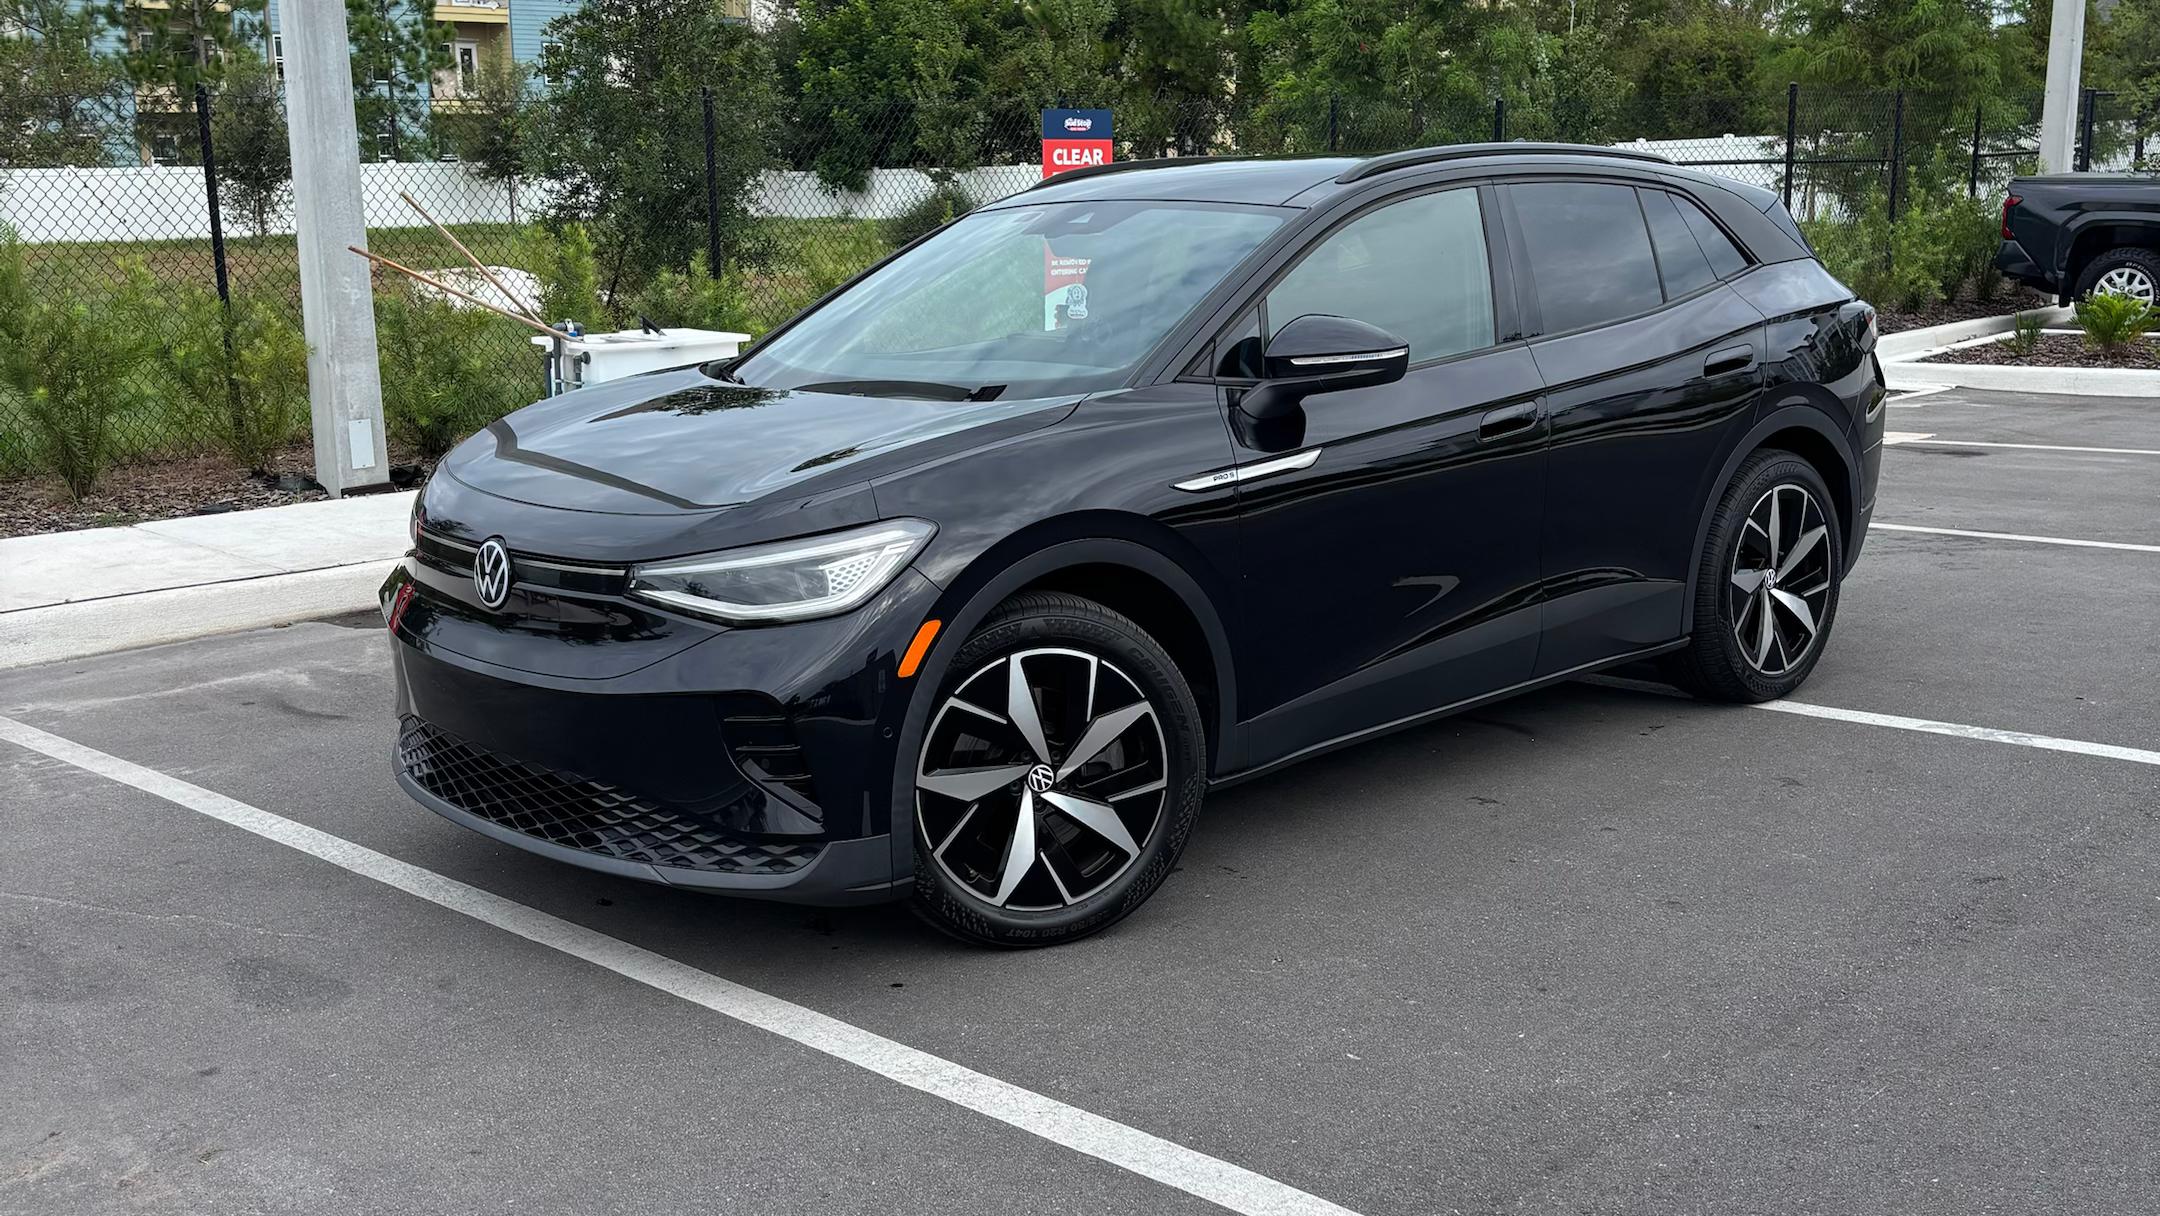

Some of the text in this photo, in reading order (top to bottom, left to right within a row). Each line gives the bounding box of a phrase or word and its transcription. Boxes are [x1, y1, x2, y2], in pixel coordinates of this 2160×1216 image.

[1053, 148, 1104, 166] CLEAR
[1213, 473, 1229, 482] PRO
[474, 541, 508, 608] VW
[1028, 764, 1054, 792] VW
